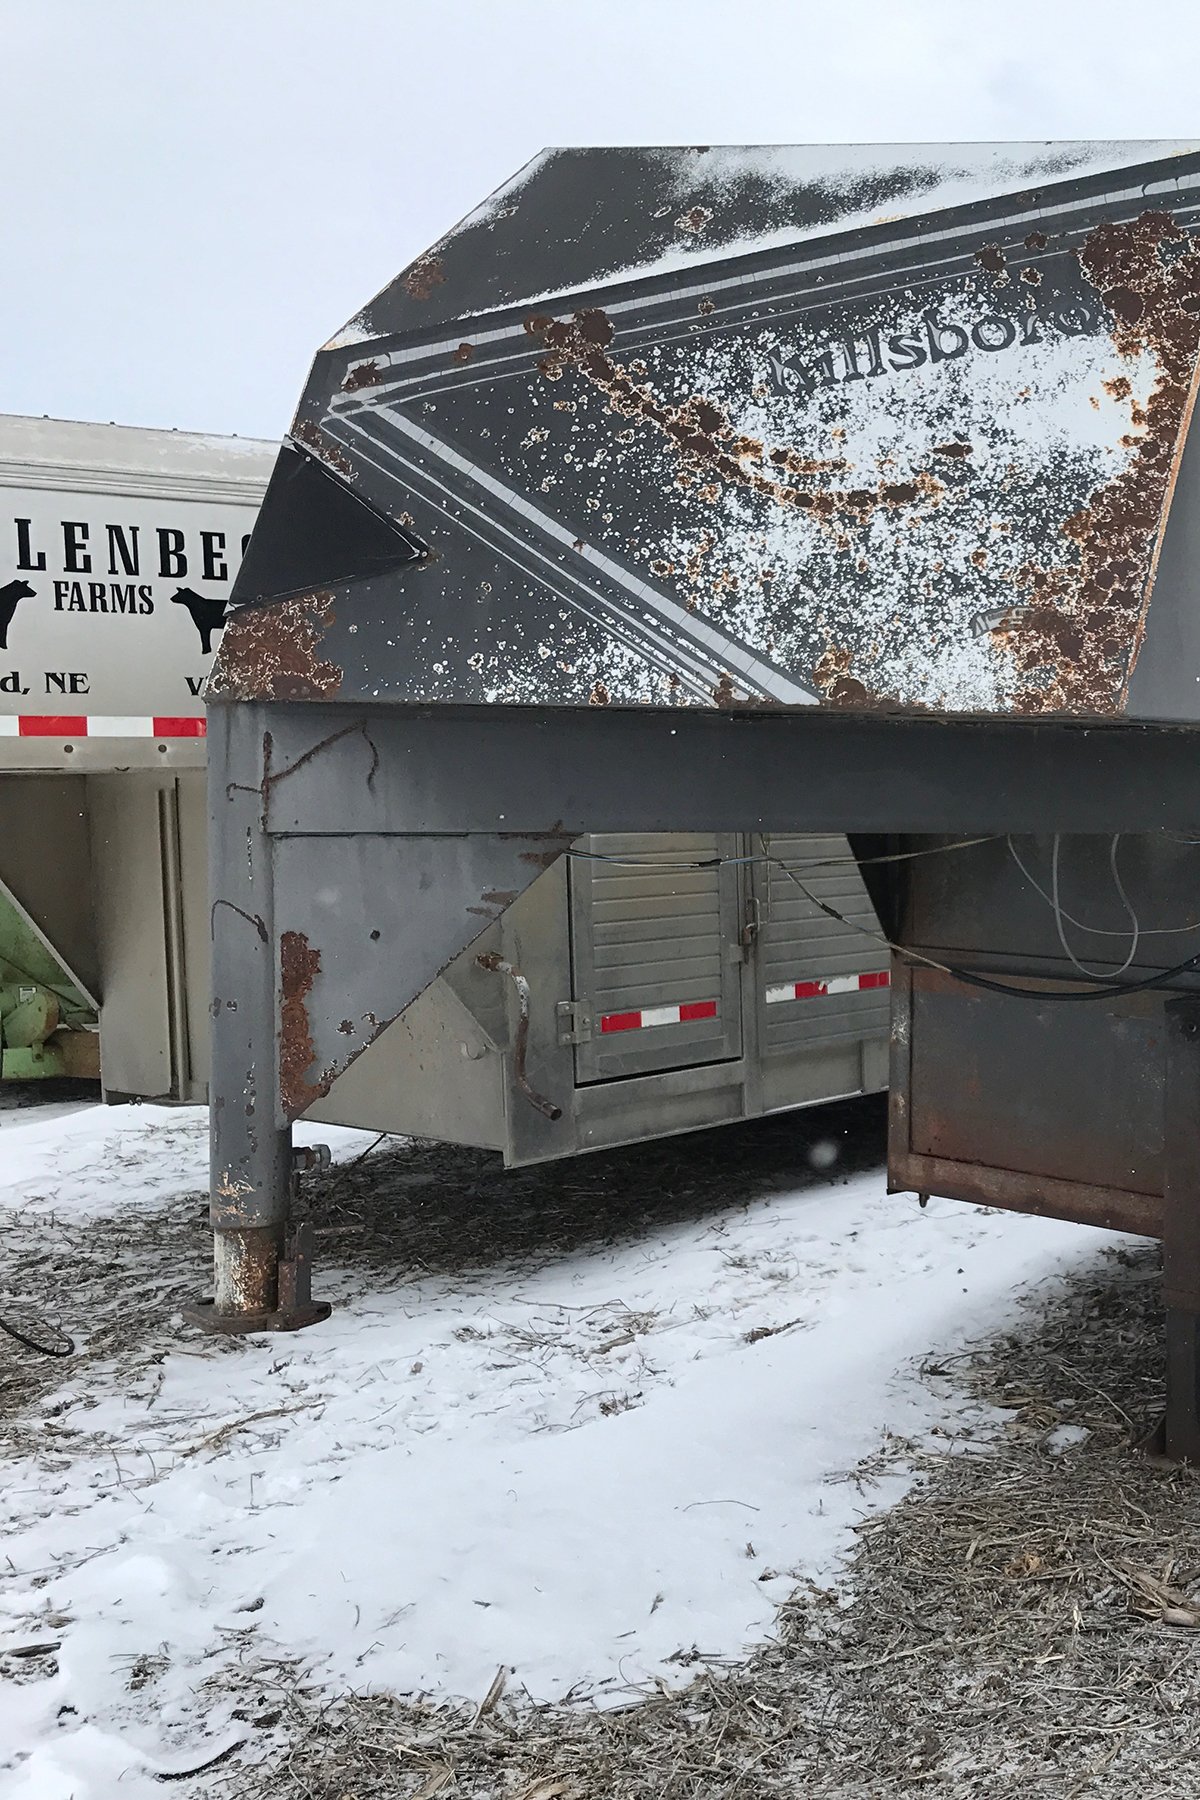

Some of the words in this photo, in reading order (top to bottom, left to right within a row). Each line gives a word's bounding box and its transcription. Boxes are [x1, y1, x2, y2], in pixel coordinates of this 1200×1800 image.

[14, 518, 253, 581] LENBE
[53, 580, 155, 615] FARMS
[44, 672, 91, 694] NE
